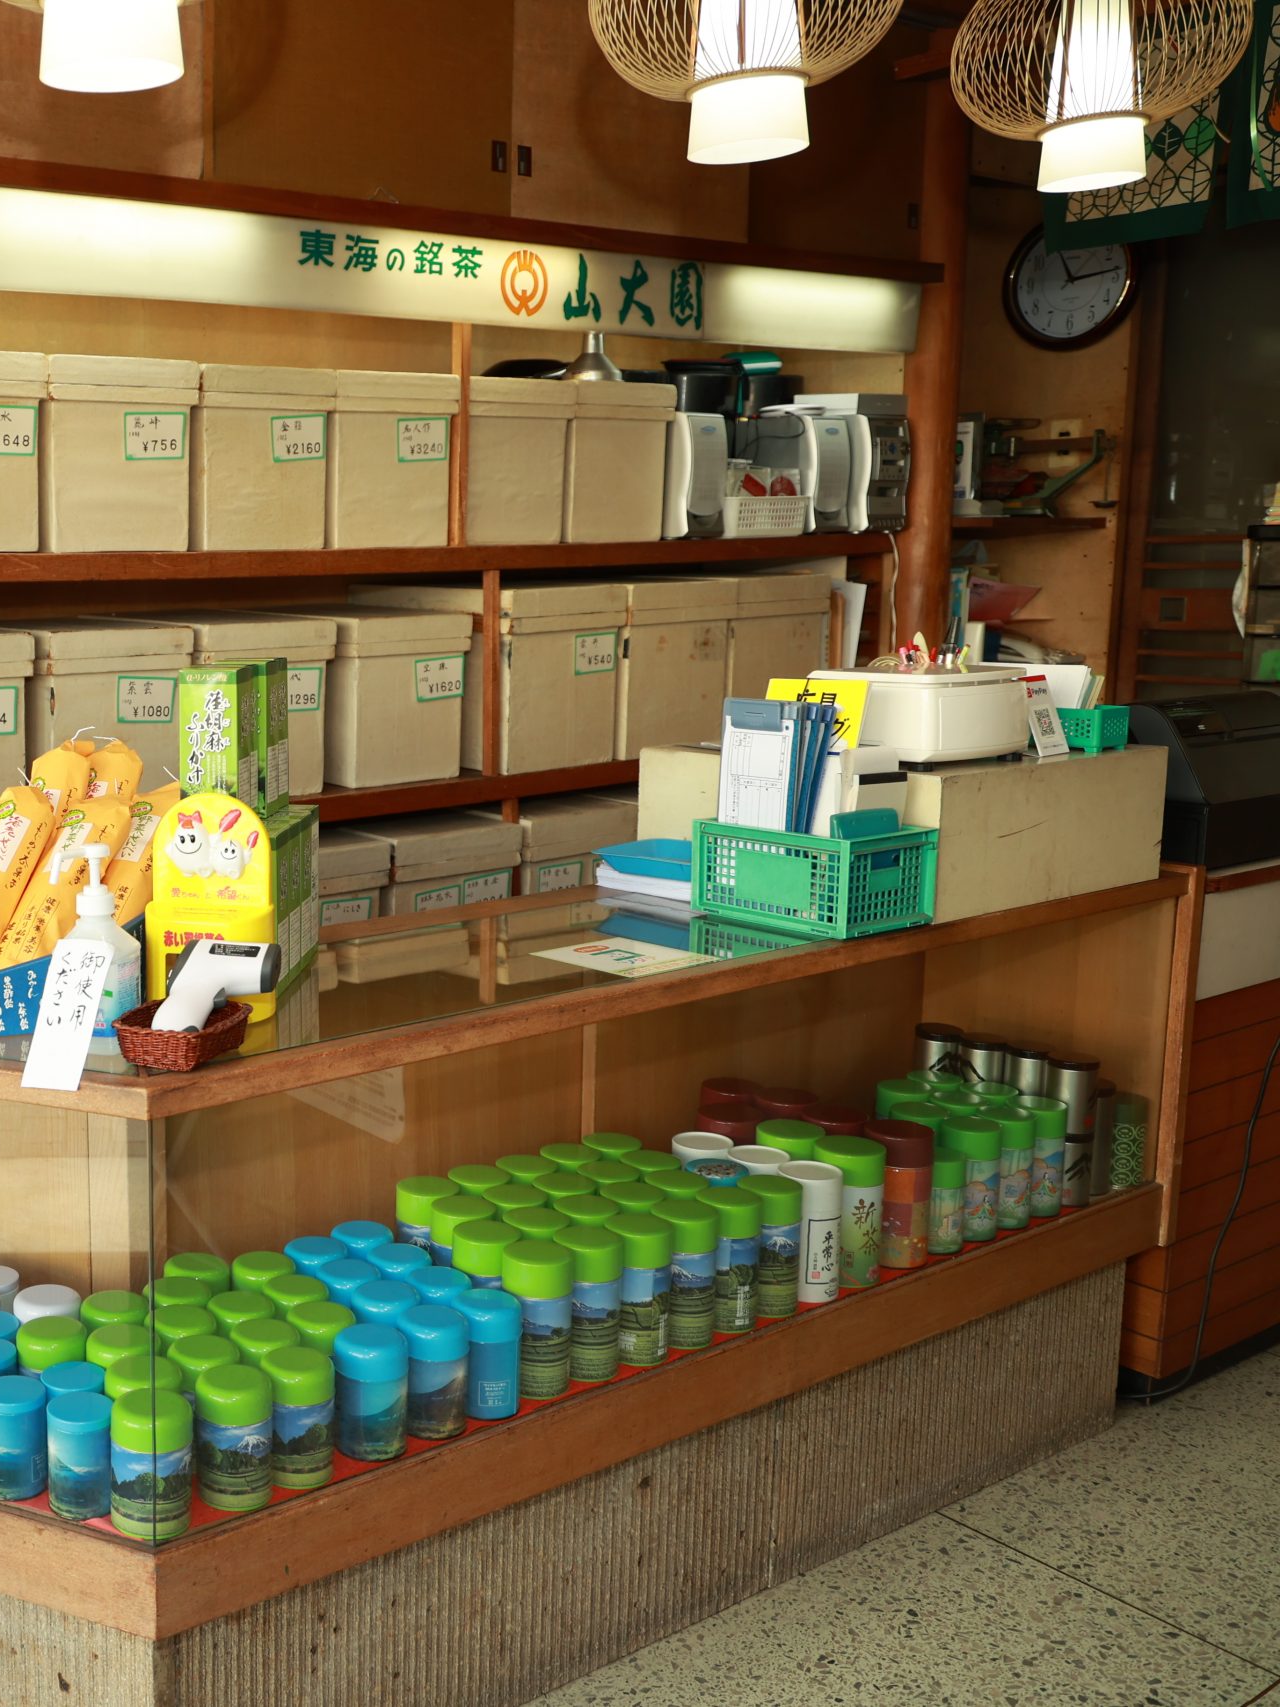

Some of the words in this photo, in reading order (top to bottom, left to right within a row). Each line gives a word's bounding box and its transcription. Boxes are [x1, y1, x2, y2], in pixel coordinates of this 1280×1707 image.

[297, 229, 484, 280] 東海の銘茶
[563, 252, 704, 331] 山大園
[142, 438, 178, 454] ¥756
[286, 442, 322, 456] ¥2160
[410, 442, 444, 456] ¥3240
[588, 653, 613, 666] ¥540
[289, 692, 317, 706] 1296
[428, 680, 462, 695] ¥1620
[133, 705, 170, 718] ¥1080
[185, 712, 205, 784] ふりかけ
[46, 951, 77, 1027] ください
[70, 951, 106, 1032] 御使用
[850, 1197, 881, 1258] 新茶
[821, 1230, 834, 1272] 平常心
